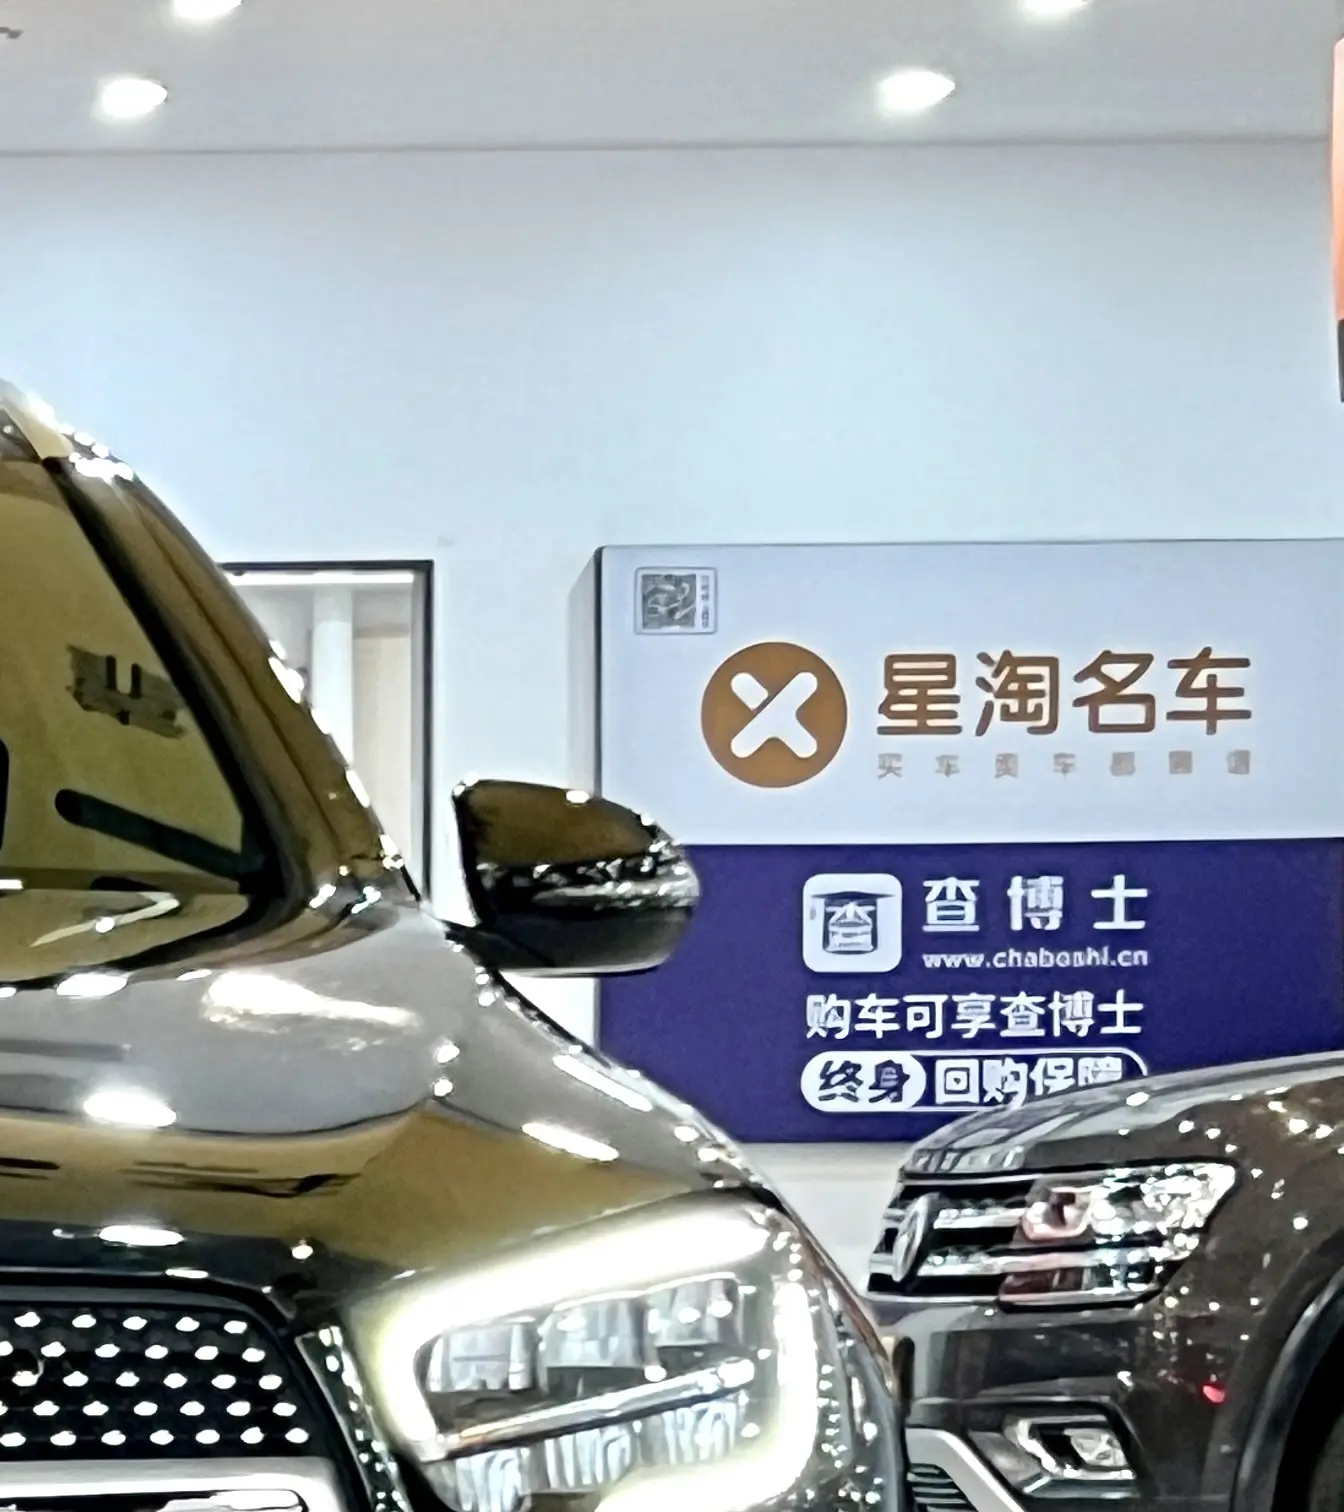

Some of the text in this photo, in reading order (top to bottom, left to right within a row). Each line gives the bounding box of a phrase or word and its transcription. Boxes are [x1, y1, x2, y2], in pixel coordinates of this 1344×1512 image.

[877, 646, 1252, 737] 星淘名车
[922, 874, 1148, 932] 查博士
[806, 989, 1144, 1040] 购车可享查博士
[817, 1060, 910, 1103] 终身
